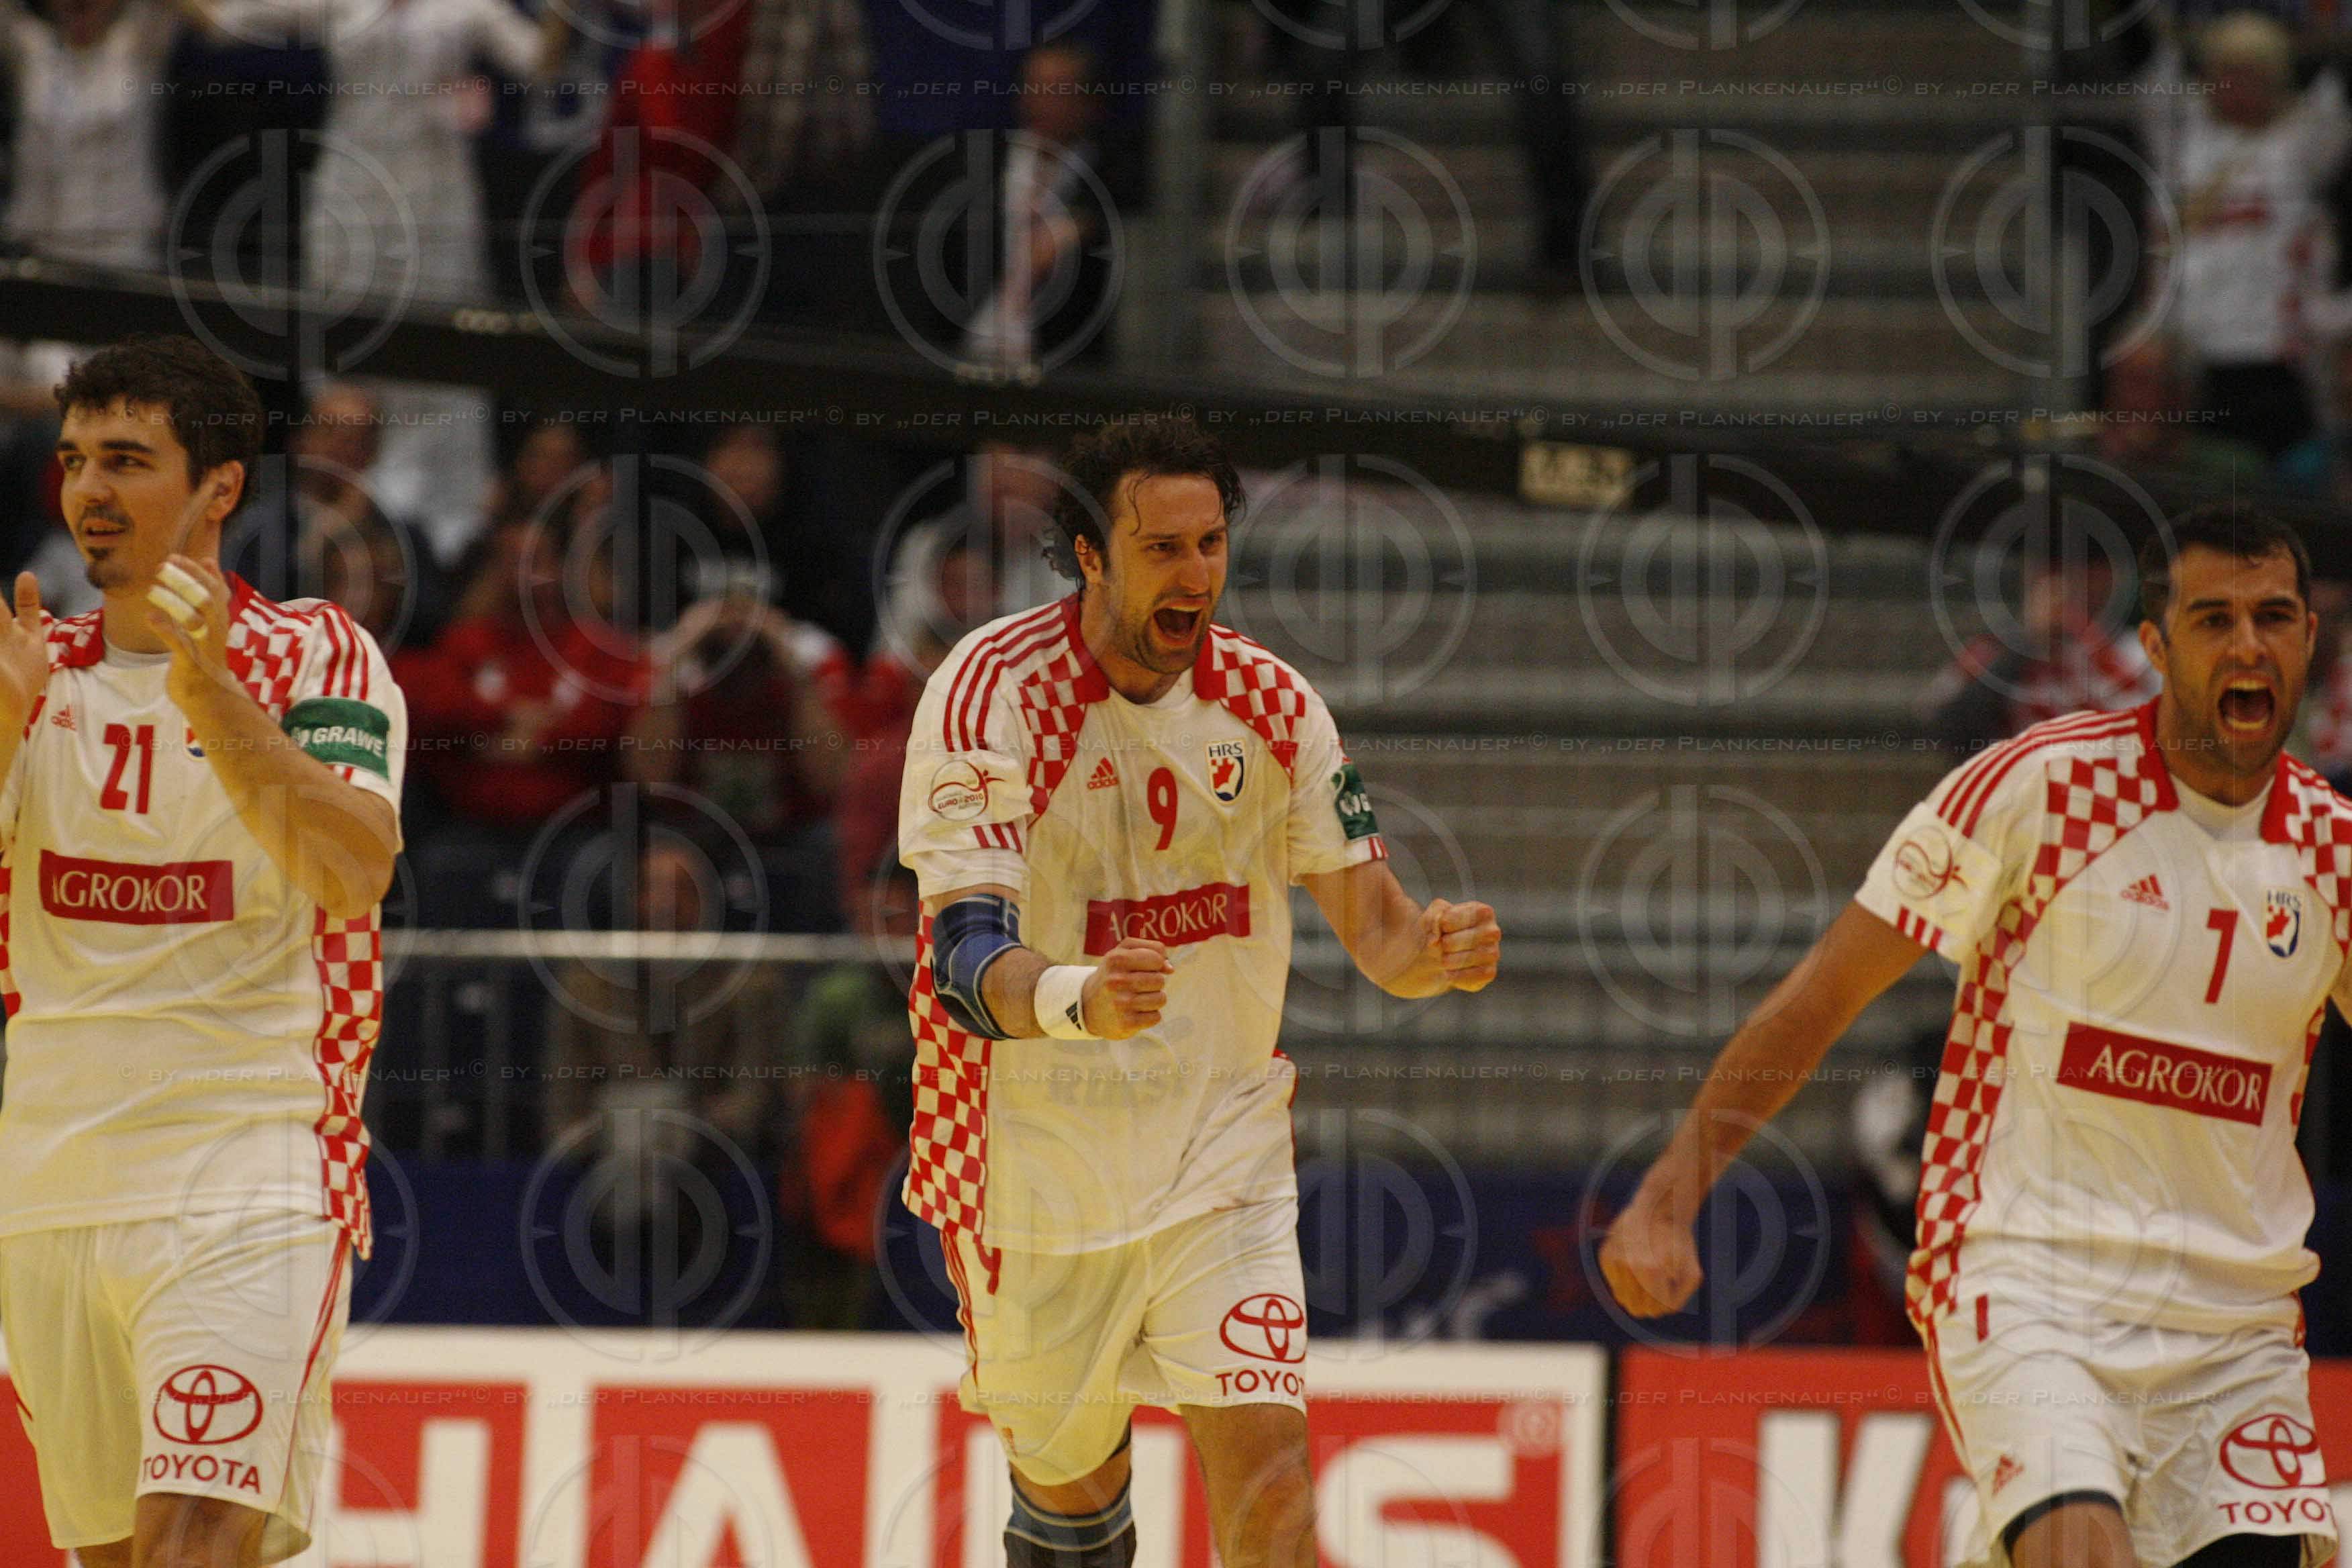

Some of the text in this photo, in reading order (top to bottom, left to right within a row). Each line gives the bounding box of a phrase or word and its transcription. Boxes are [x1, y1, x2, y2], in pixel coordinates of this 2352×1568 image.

[312, 726, 384, 758] GRAWE
[1208, 742, 1242, 758] HRS
[100, 723, 154, 815] 21
[1146, 767, 1178, 851] 9
[2204, 908, 2239, 1005] 7
[2086, 1043, 2261, 1112] AGROKOR
[1215, 1369, 1305, 1397] TOYO
[142, 1453, 262, 1494] TOYOTA
[2218, 1498, 2332, 1525] TOYO
